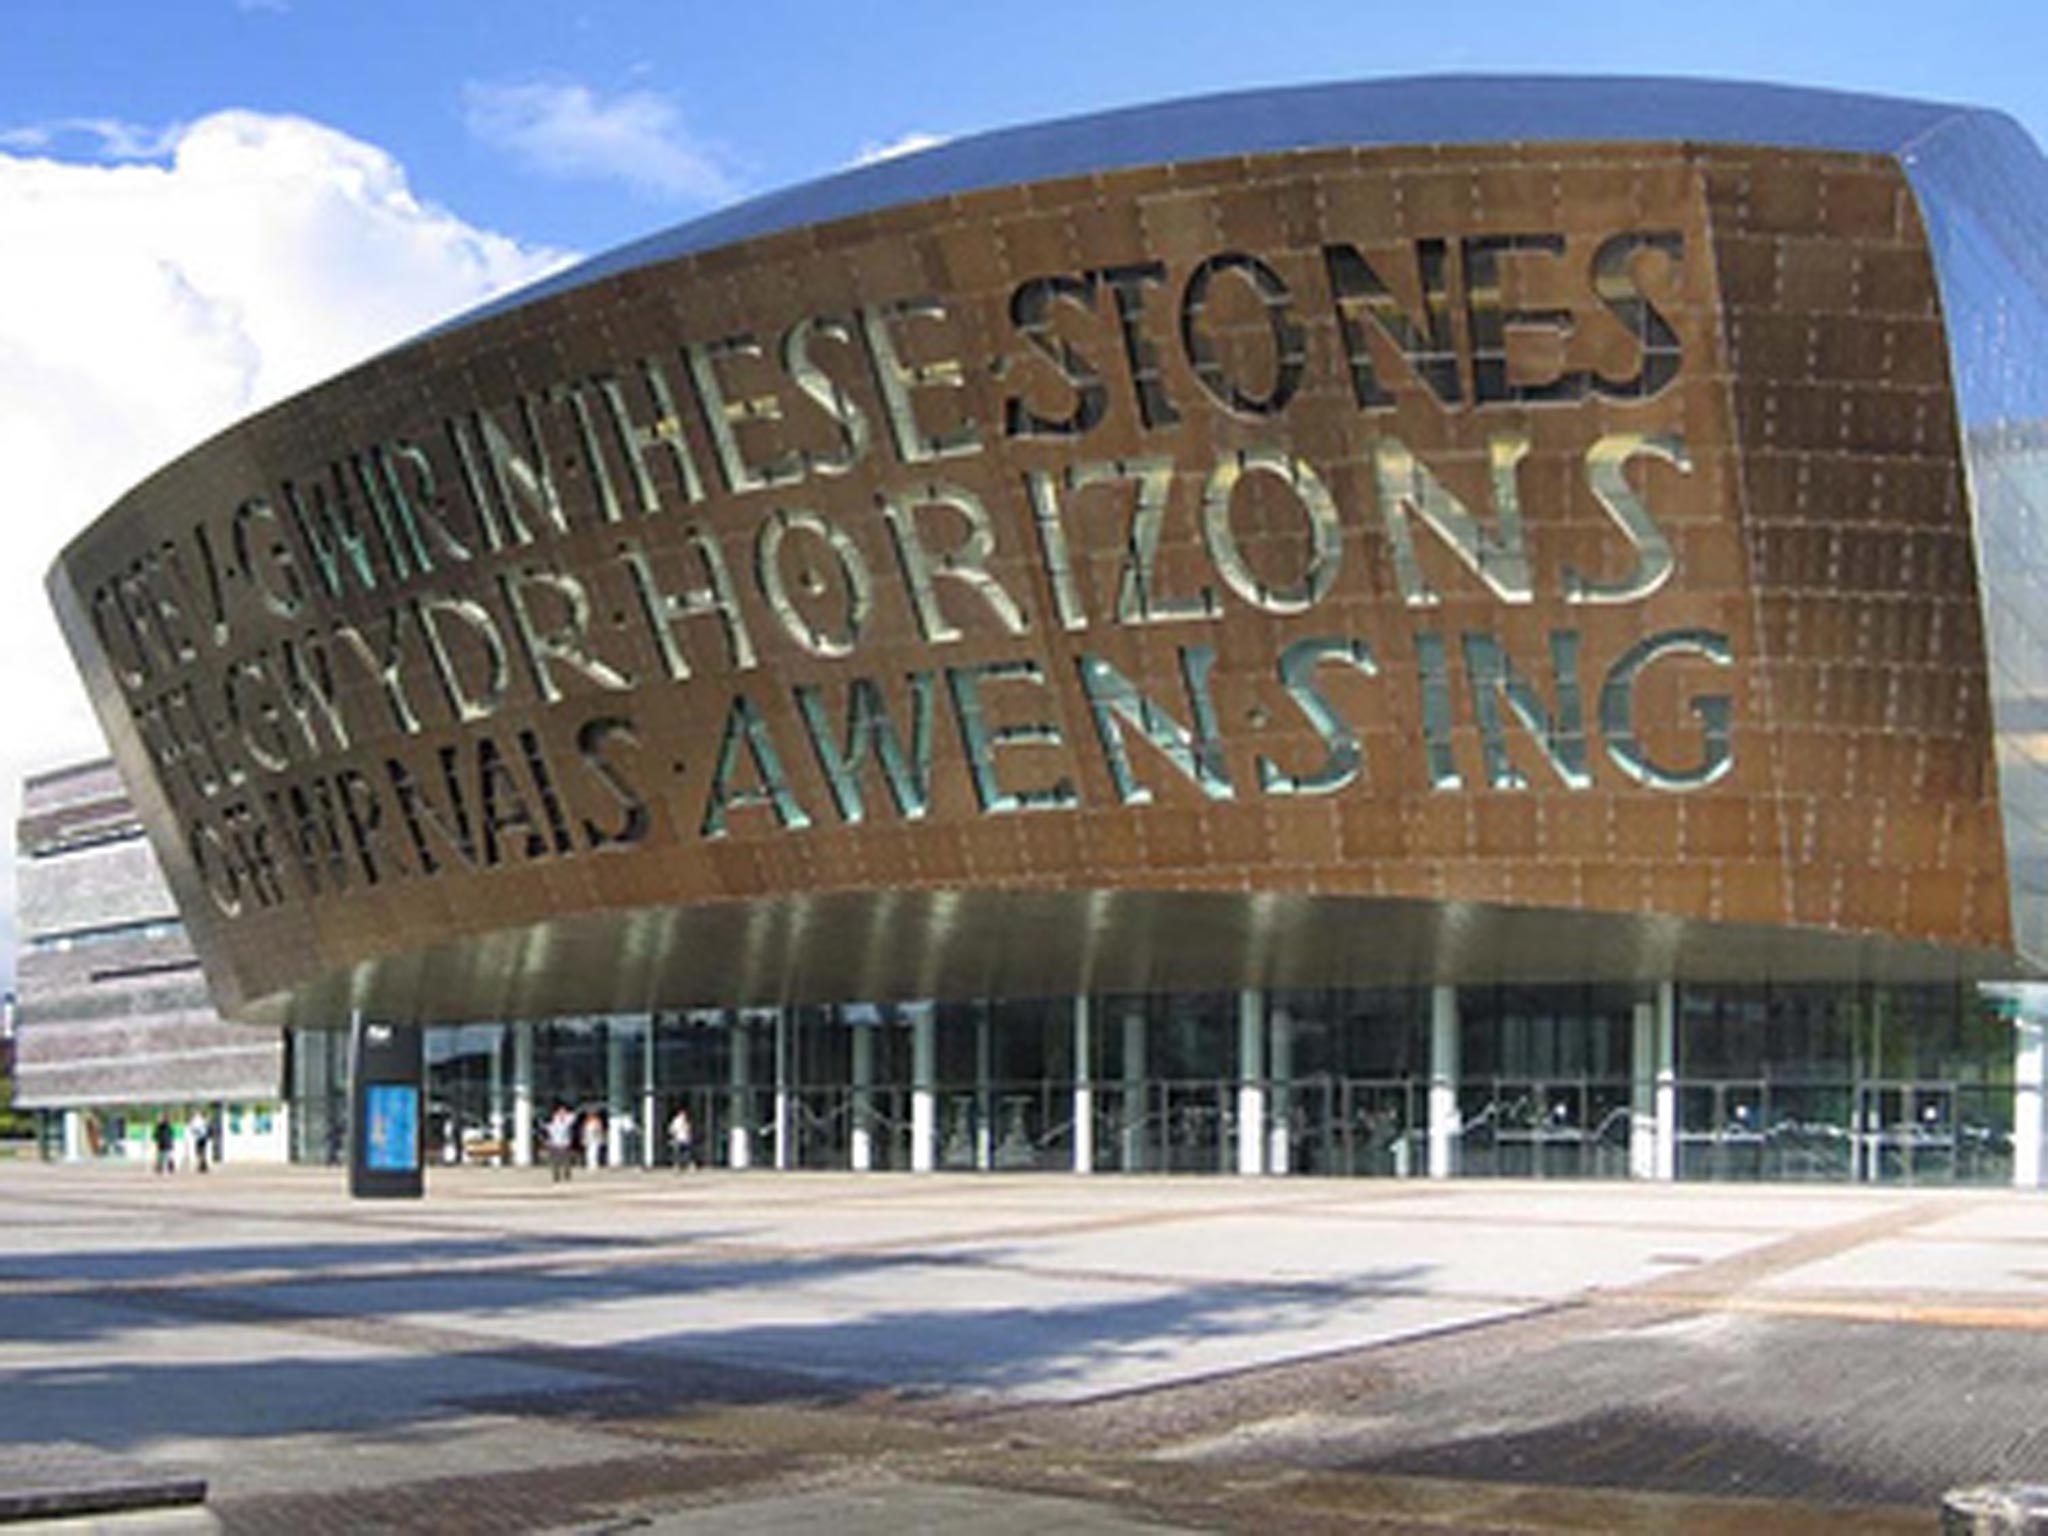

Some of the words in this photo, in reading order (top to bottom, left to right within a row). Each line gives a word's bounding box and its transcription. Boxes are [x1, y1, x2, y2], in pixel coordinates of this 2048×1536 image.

[542, 296, 984, 523] THESE
[1004, 229, 1685, 441] STONES
[225, 562, 637, 773] GWYDR
[616, 432, 1694, 682] HORIZONS
[701, 644, 1236, 840] AWEN
[1256, 627, 1733, 795] SING
